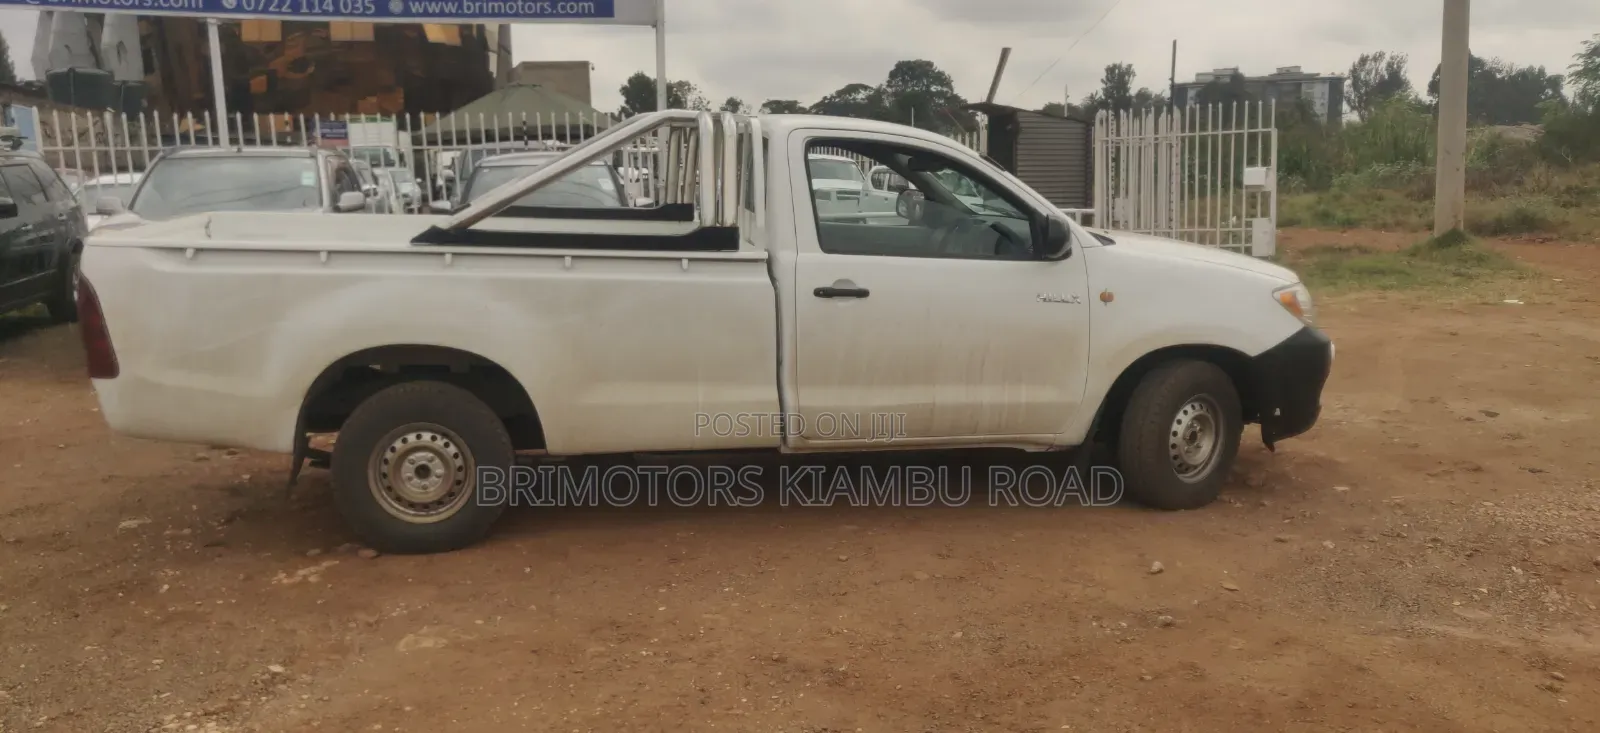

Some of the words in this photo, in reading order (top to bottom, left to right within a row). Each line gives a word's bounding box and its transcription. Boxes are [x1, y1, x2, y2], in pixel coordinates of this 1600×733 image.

[243, 0, 292, 12] 0722
[300, 0, 334, 13] 114
[339, 0, 375, 14] 035
[408, 0, 595, 14] www.brimotors.com
